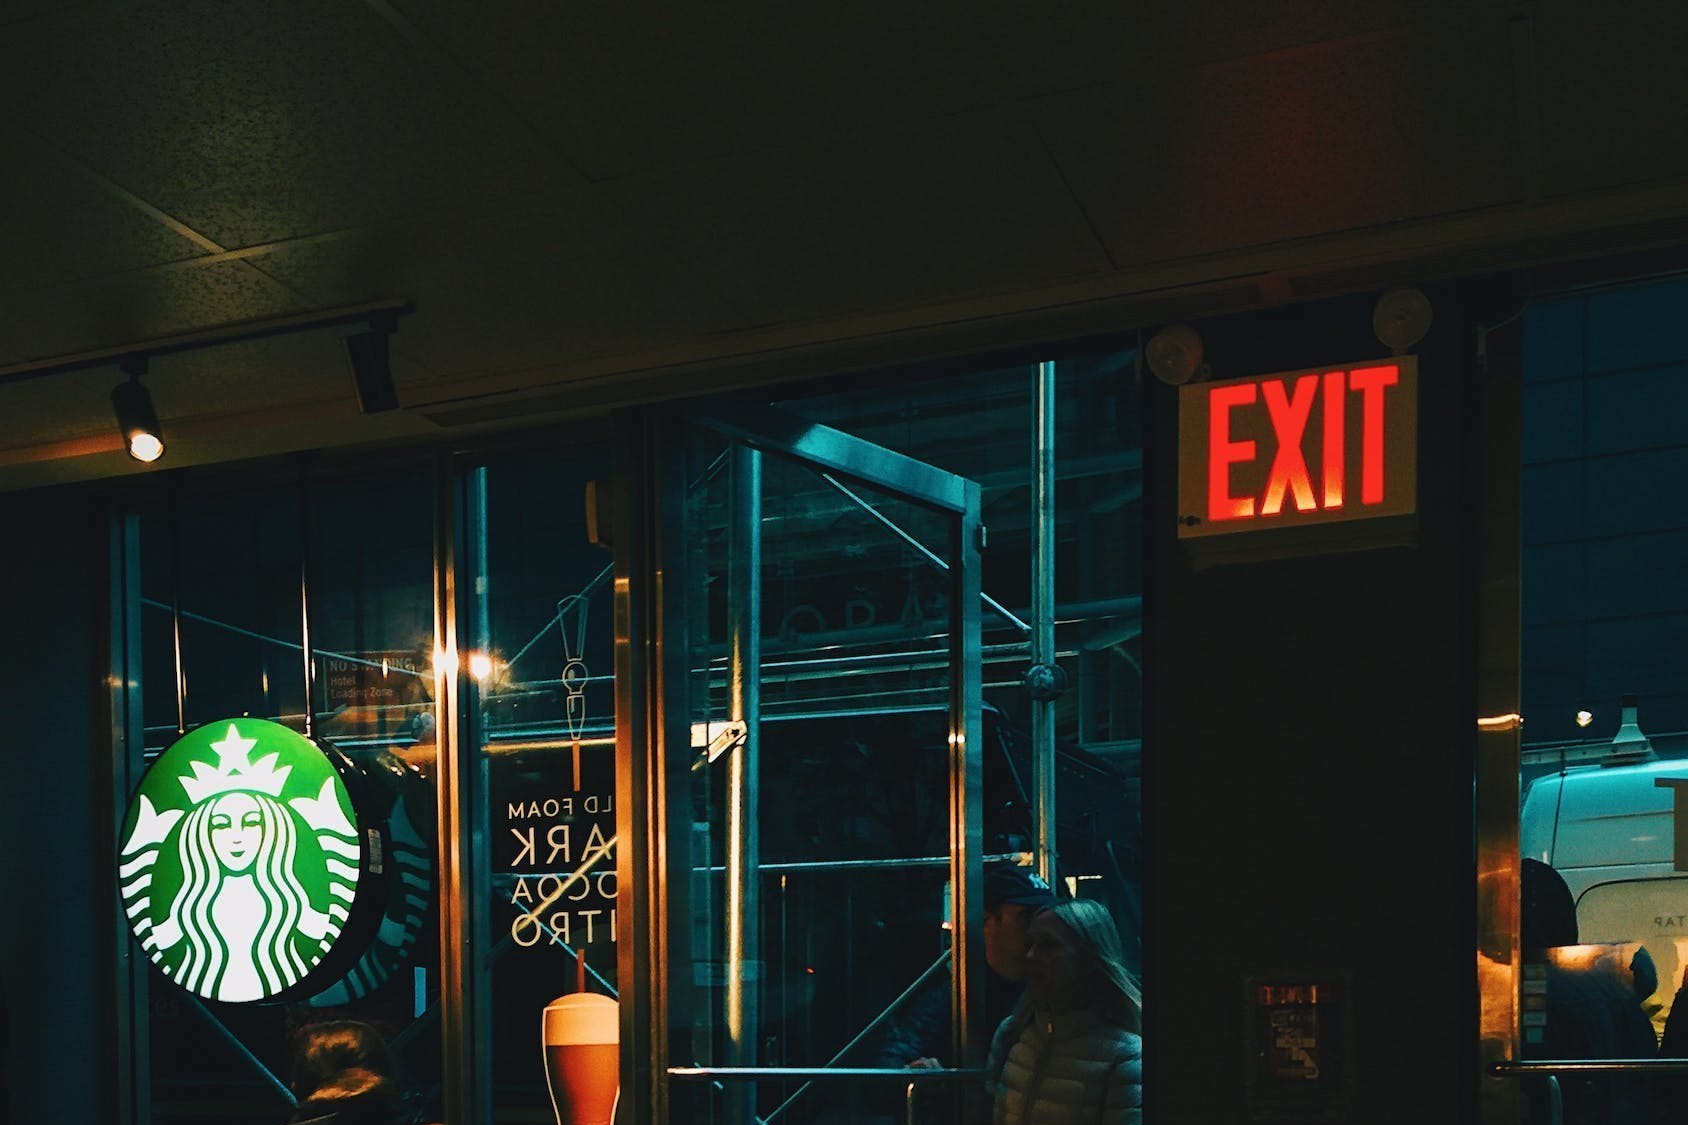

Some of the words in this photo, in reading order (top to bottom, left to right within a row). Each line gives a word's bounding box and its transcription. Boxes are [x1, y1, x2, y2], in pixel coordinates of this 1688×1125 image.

[1207, 364, 1399, 522] EXIT
[330, 675, 357, 687] Hotel
[369, 686, 394, 698] Zone
